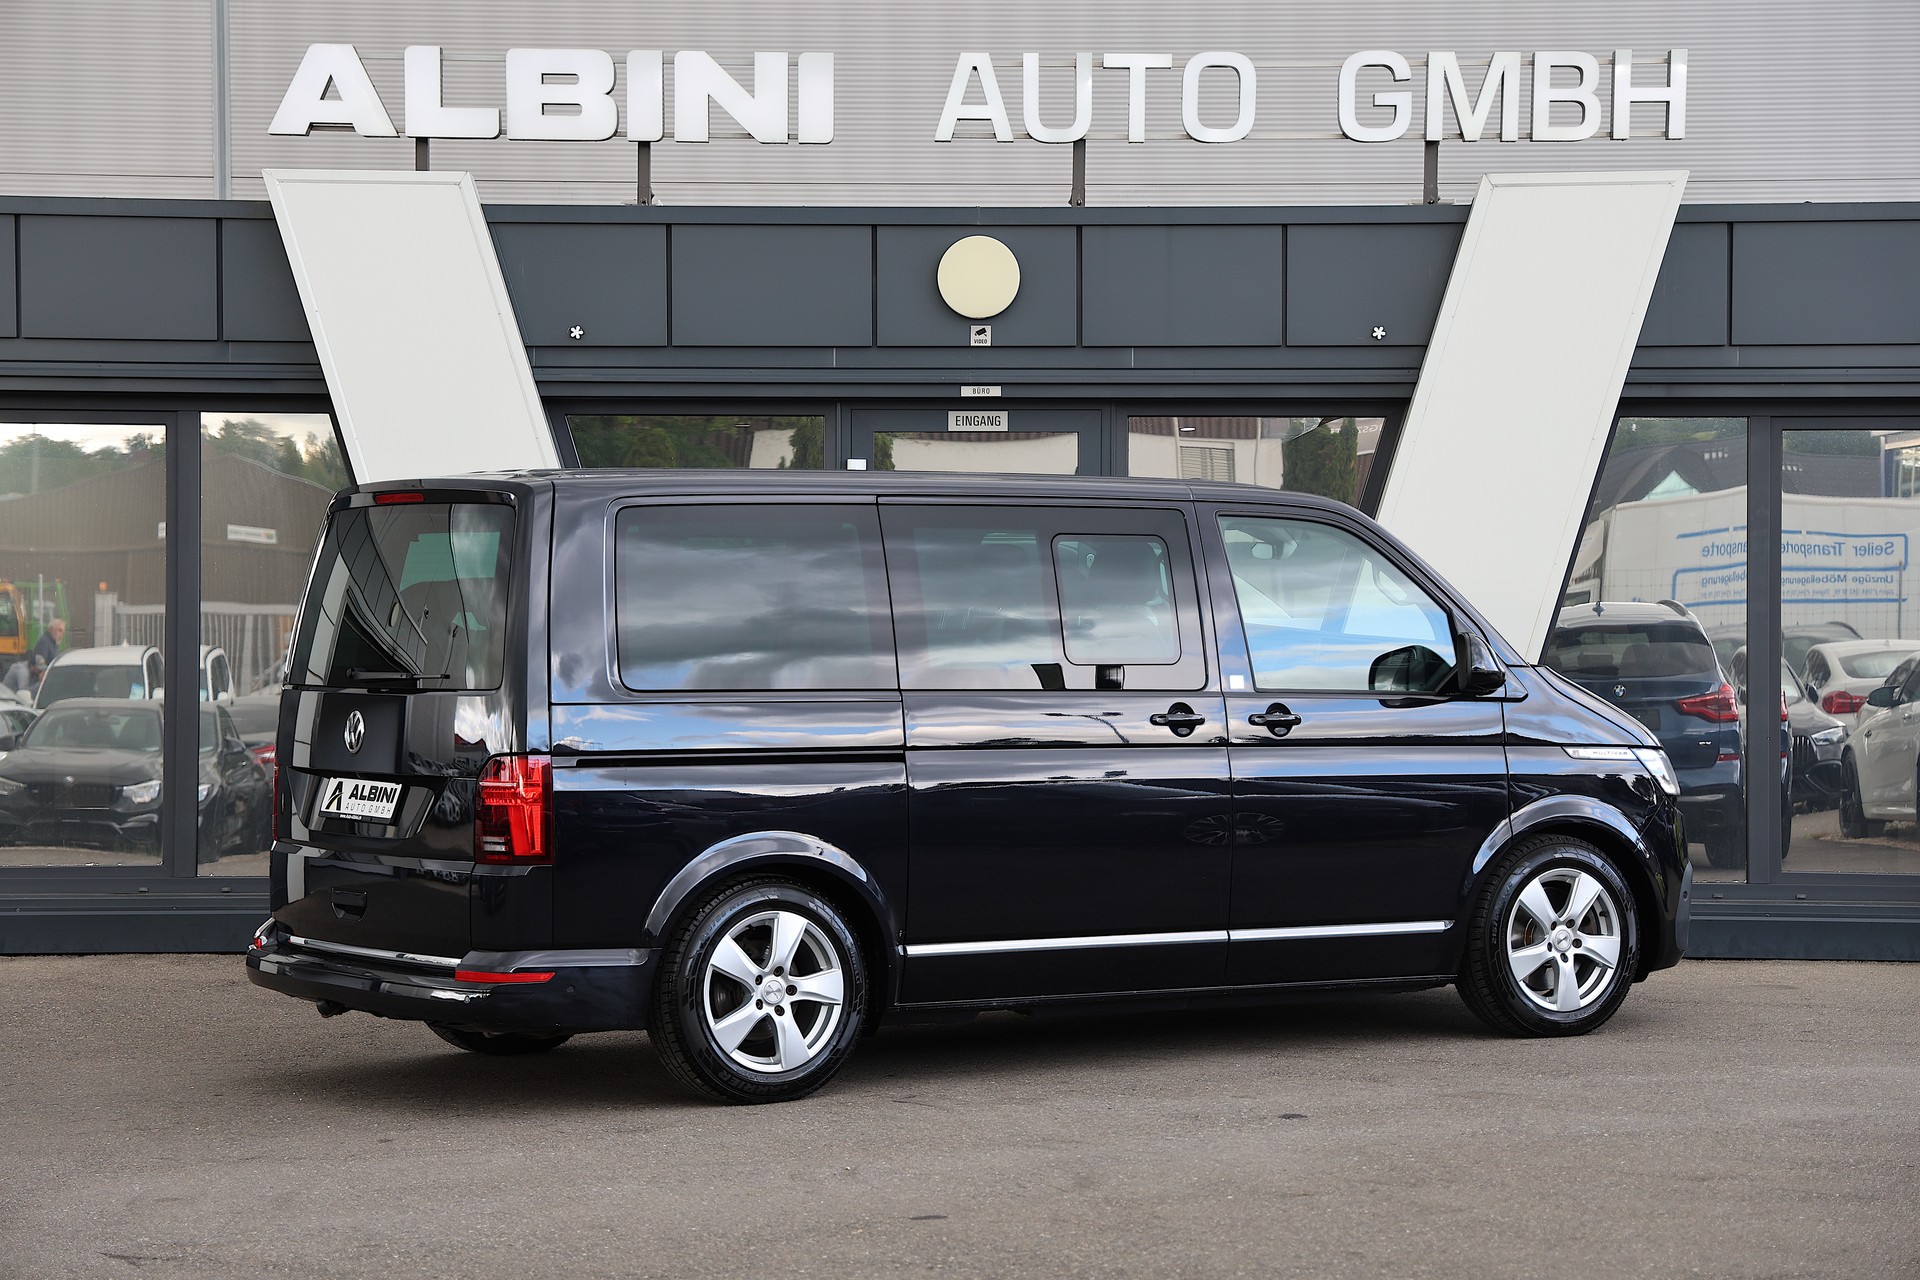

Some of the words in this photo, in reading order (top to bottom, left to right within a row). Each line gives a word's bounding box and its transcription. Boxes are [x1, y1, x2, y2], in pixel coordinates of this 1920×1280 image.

[267, 43, 835, 144] ALBINI
[934, 51, 1257, 143] AUTO
[1337, 48, 1689, 143] GMBH
[972, 386, 991, 395] BÜRO
[955, 415, 1001, 427] EINGANG
[348, 783, 398, 804] ALBINI
[344, 802, 366, 813] AUTO
[368, 804, 392, 815] GMBH
